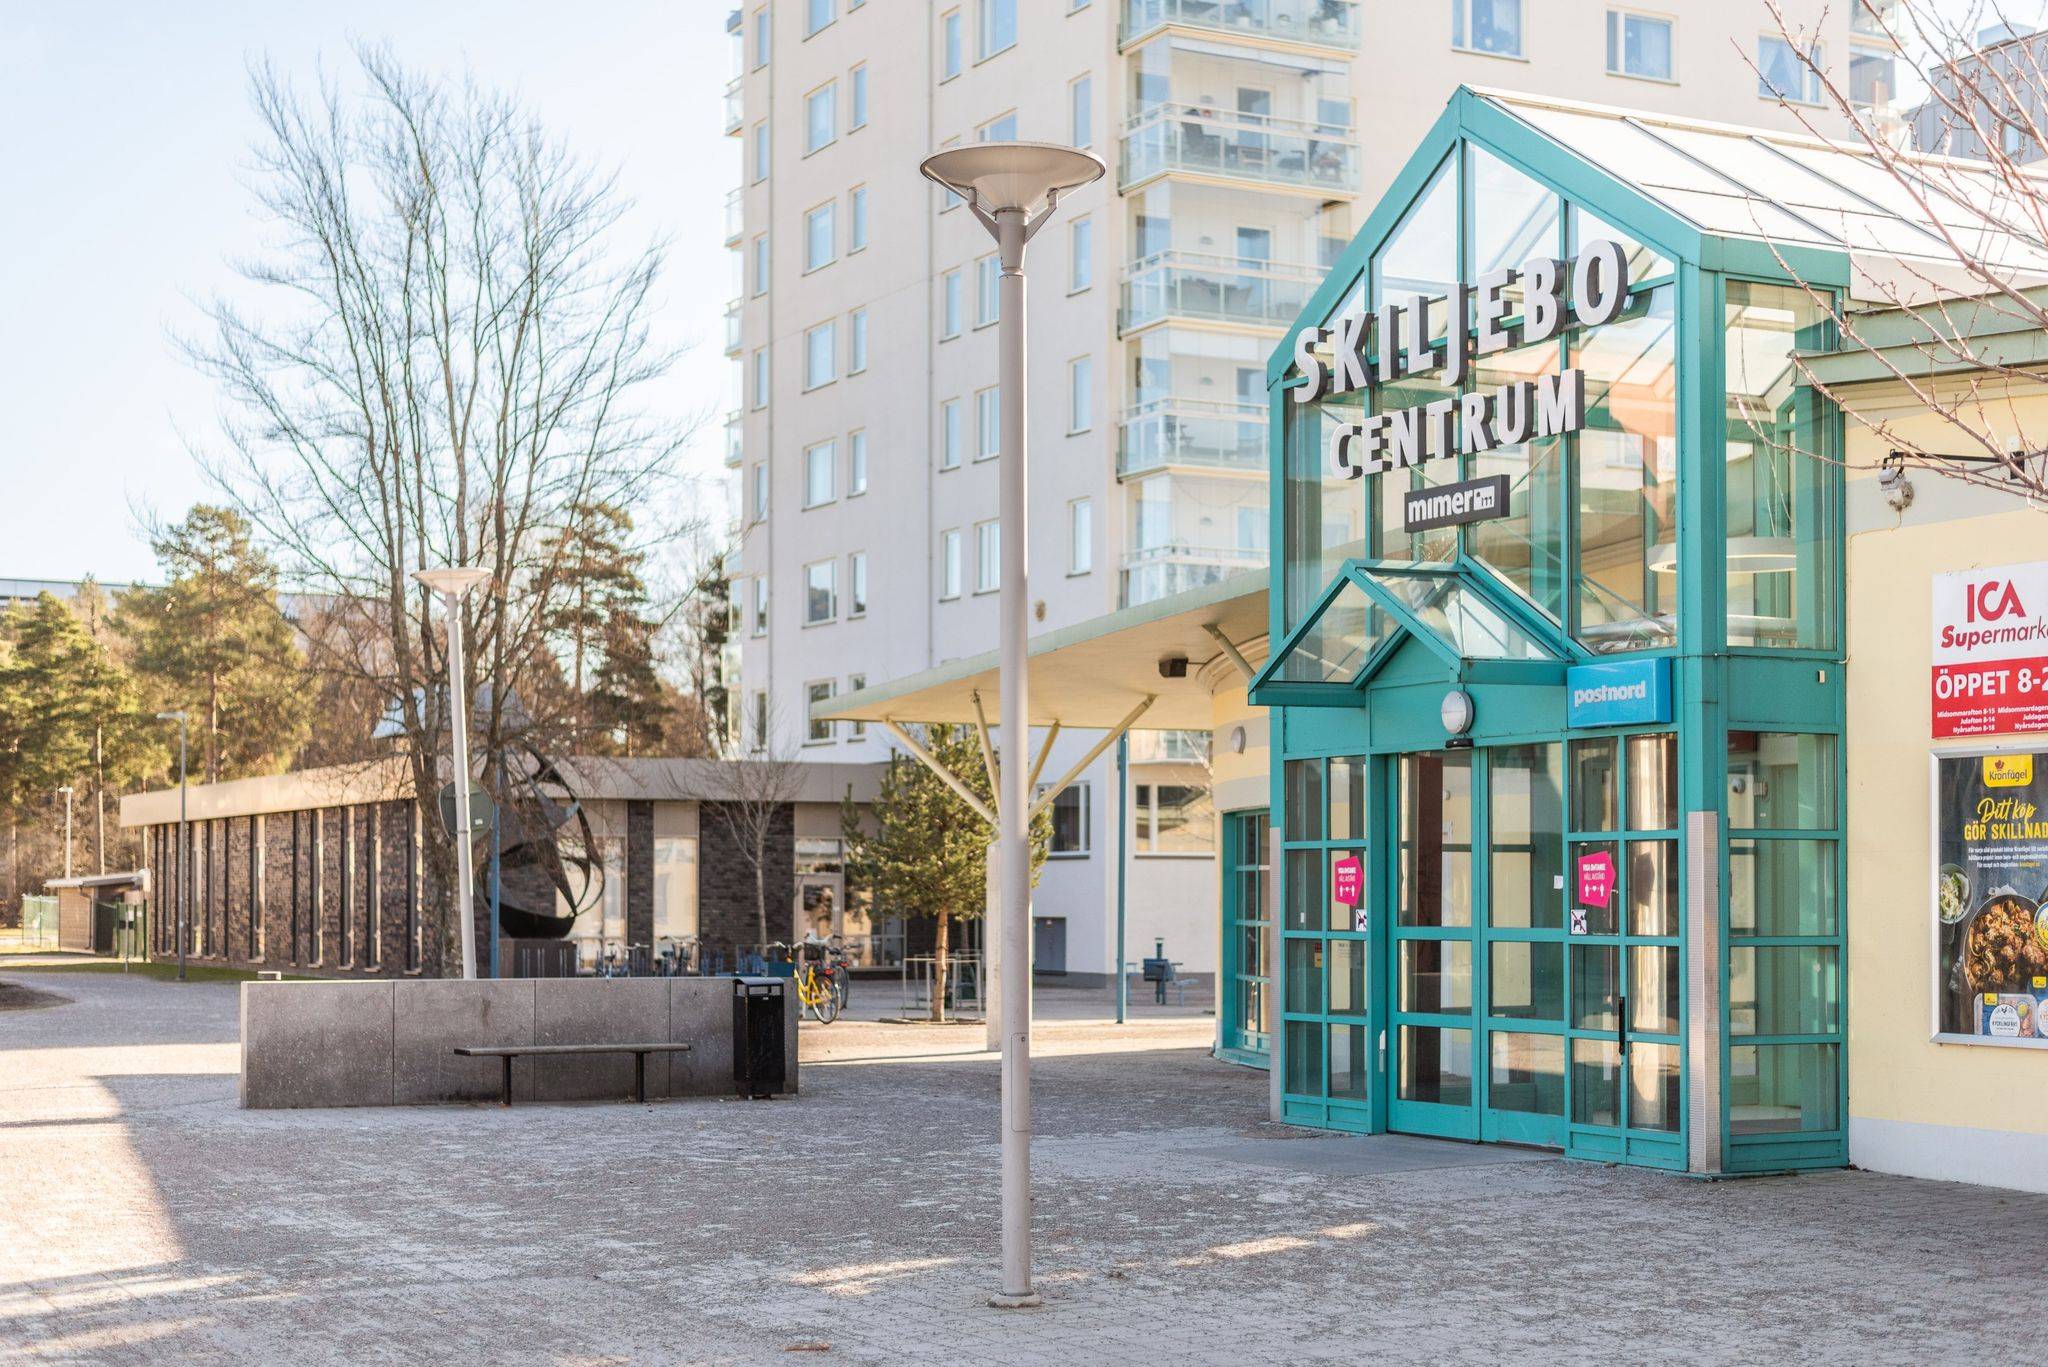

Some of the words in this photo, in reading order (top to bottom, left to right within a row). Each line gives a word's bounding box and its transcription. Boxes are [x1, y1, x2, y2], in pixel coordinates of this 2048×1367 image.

[1294, 239, 1628, 403] SKILJEBO
[1330, 368, 1584, 480] CENTRUM
[1408, 490, 1473, 523] mimer
[1966, 579, 2027, 623] ICA
[1941, 616, 2048, 651] Supermark
[1574, 680, 1646, 708] postnord
[1935, 668, 2010, 699] ÖPPET
[1989, 769, 2027, 782] Kronfågel
[1977, 797, 2013, 823] Ditt
[2012, 798, 2037, 824] köp
[1964, 821, 1986, 840] GÖR
[1991, 822, 2048, 840] SKILLNAD
